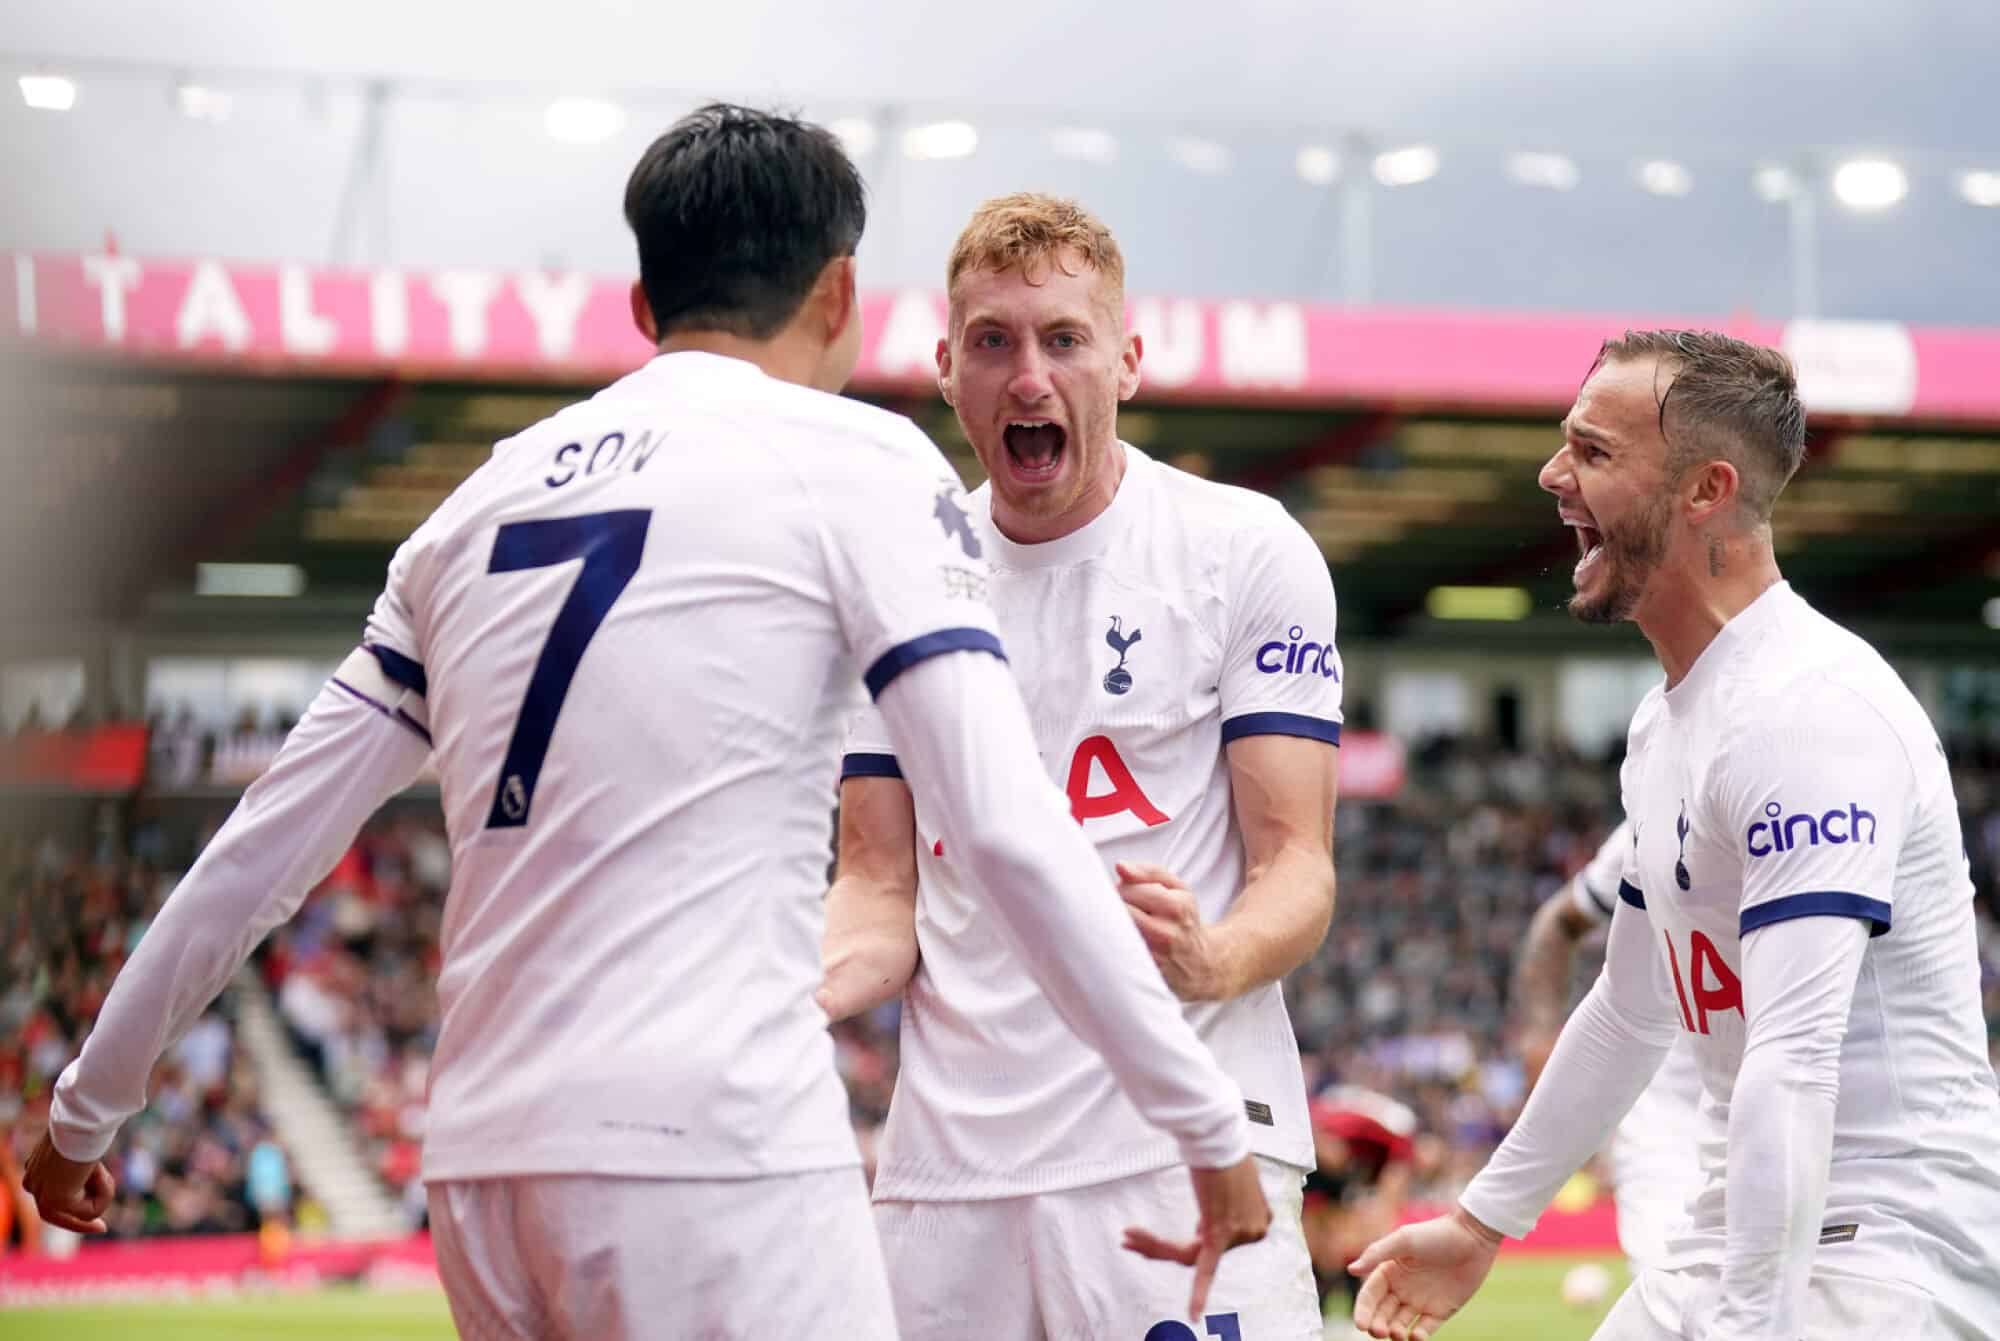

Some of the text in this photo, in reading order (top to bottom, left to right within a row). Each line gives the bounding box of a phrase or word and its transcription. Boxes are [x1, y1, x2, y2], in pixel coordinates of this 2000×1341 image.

[545, 430, 670, 488] SON
[486, 508, 652, 829] 7
[1256, 625, 1340, 683] cinc
[1747, 802, 1876, 857] cinch
[1664, 928, 1745, 1035] IA
